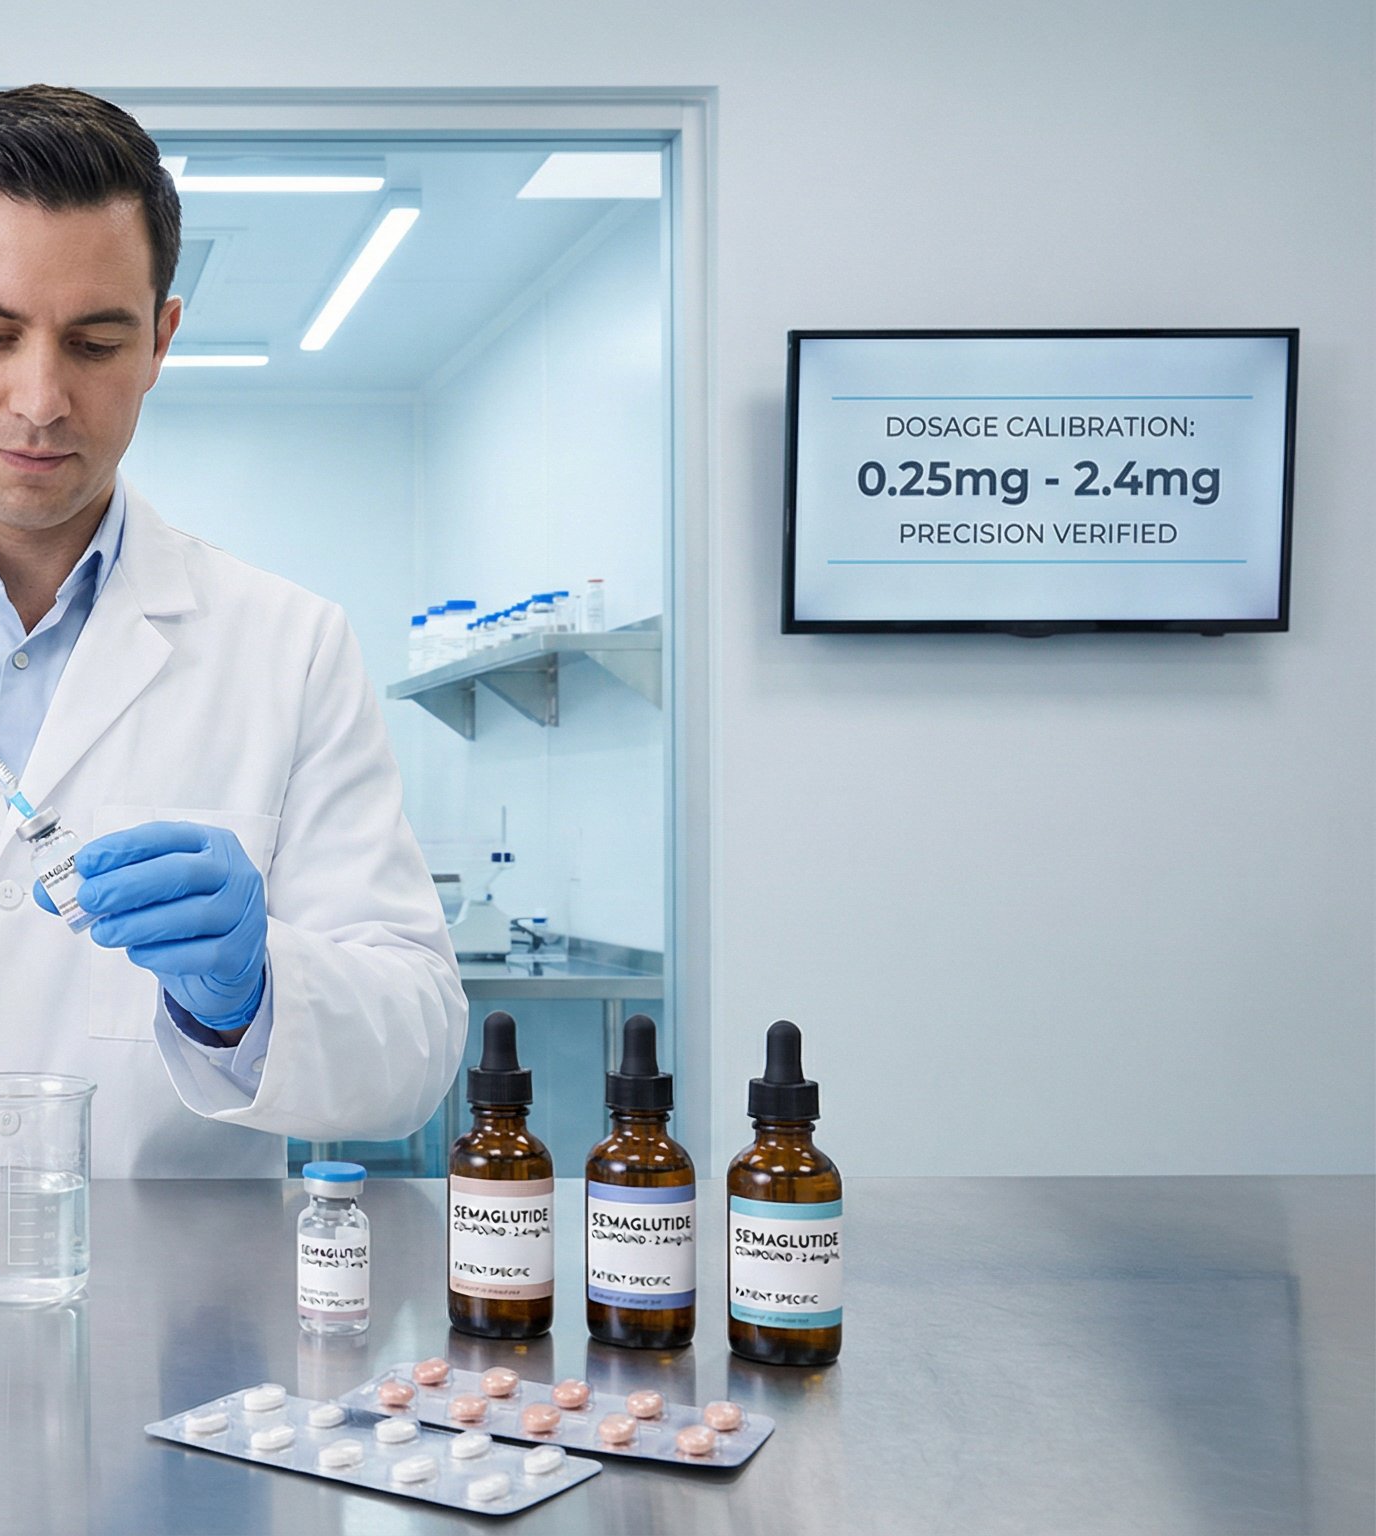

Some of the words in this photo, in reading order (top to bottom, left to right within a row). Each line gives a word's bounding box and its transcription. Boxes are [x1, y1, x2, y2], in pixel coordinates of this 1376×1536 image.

[885, 415, 999, 438] DOSAGE
[1006, 415, 1196, 438] CALIBRATION:
[857, 460, 1030, 505] 0.25mg
[1045, 477, 1060, 486] -
[1073, 460, 1221, 505] 2.4mg
[899, 522, 1044, 544] PRECISION
[1052, 522, 1178, 544] VERIFIED
[453, 1204, 549, 1224] SEMAGLUTIDE
[591, 1211, 692, 1232] SEMAGLUTIDE
[735, 1227, 840, 1249] SEMAGLUTIDE
